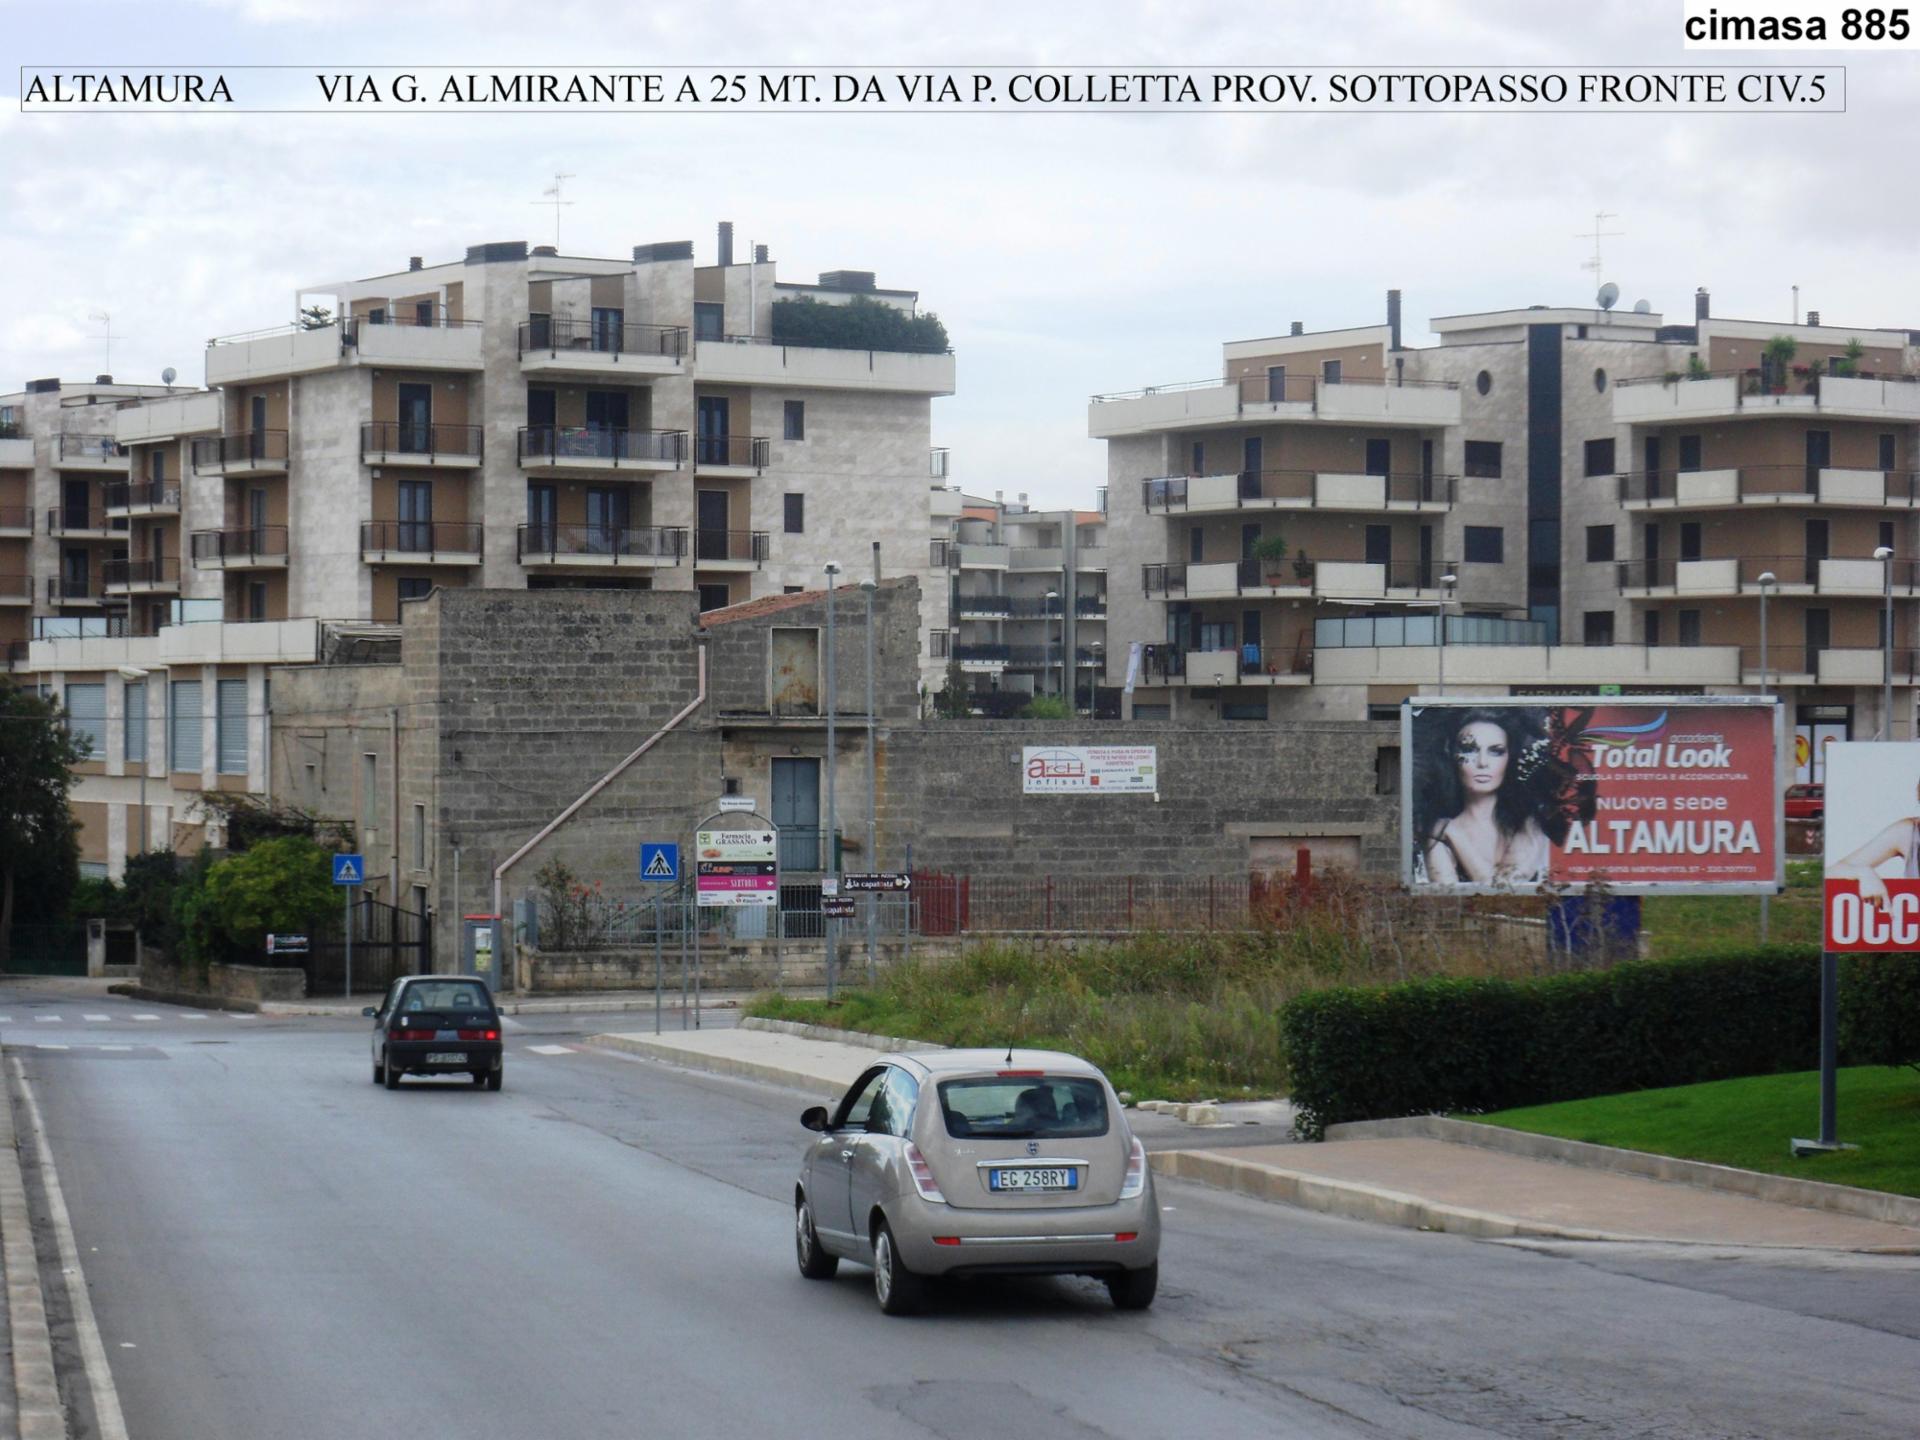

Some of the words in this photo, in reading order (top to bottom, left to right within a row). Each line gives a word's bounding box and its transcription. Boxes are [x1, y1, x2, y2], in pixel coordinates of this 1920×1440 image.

[1591, 743, 1662, 768] Total
[1665, 743, 1733, 768] Look
[1564, 820, 1761, 854] ALTAMURA
[1001, 1172, 1018, 1187] EG
[1023, 1169, 1067, 1186] 258RY
